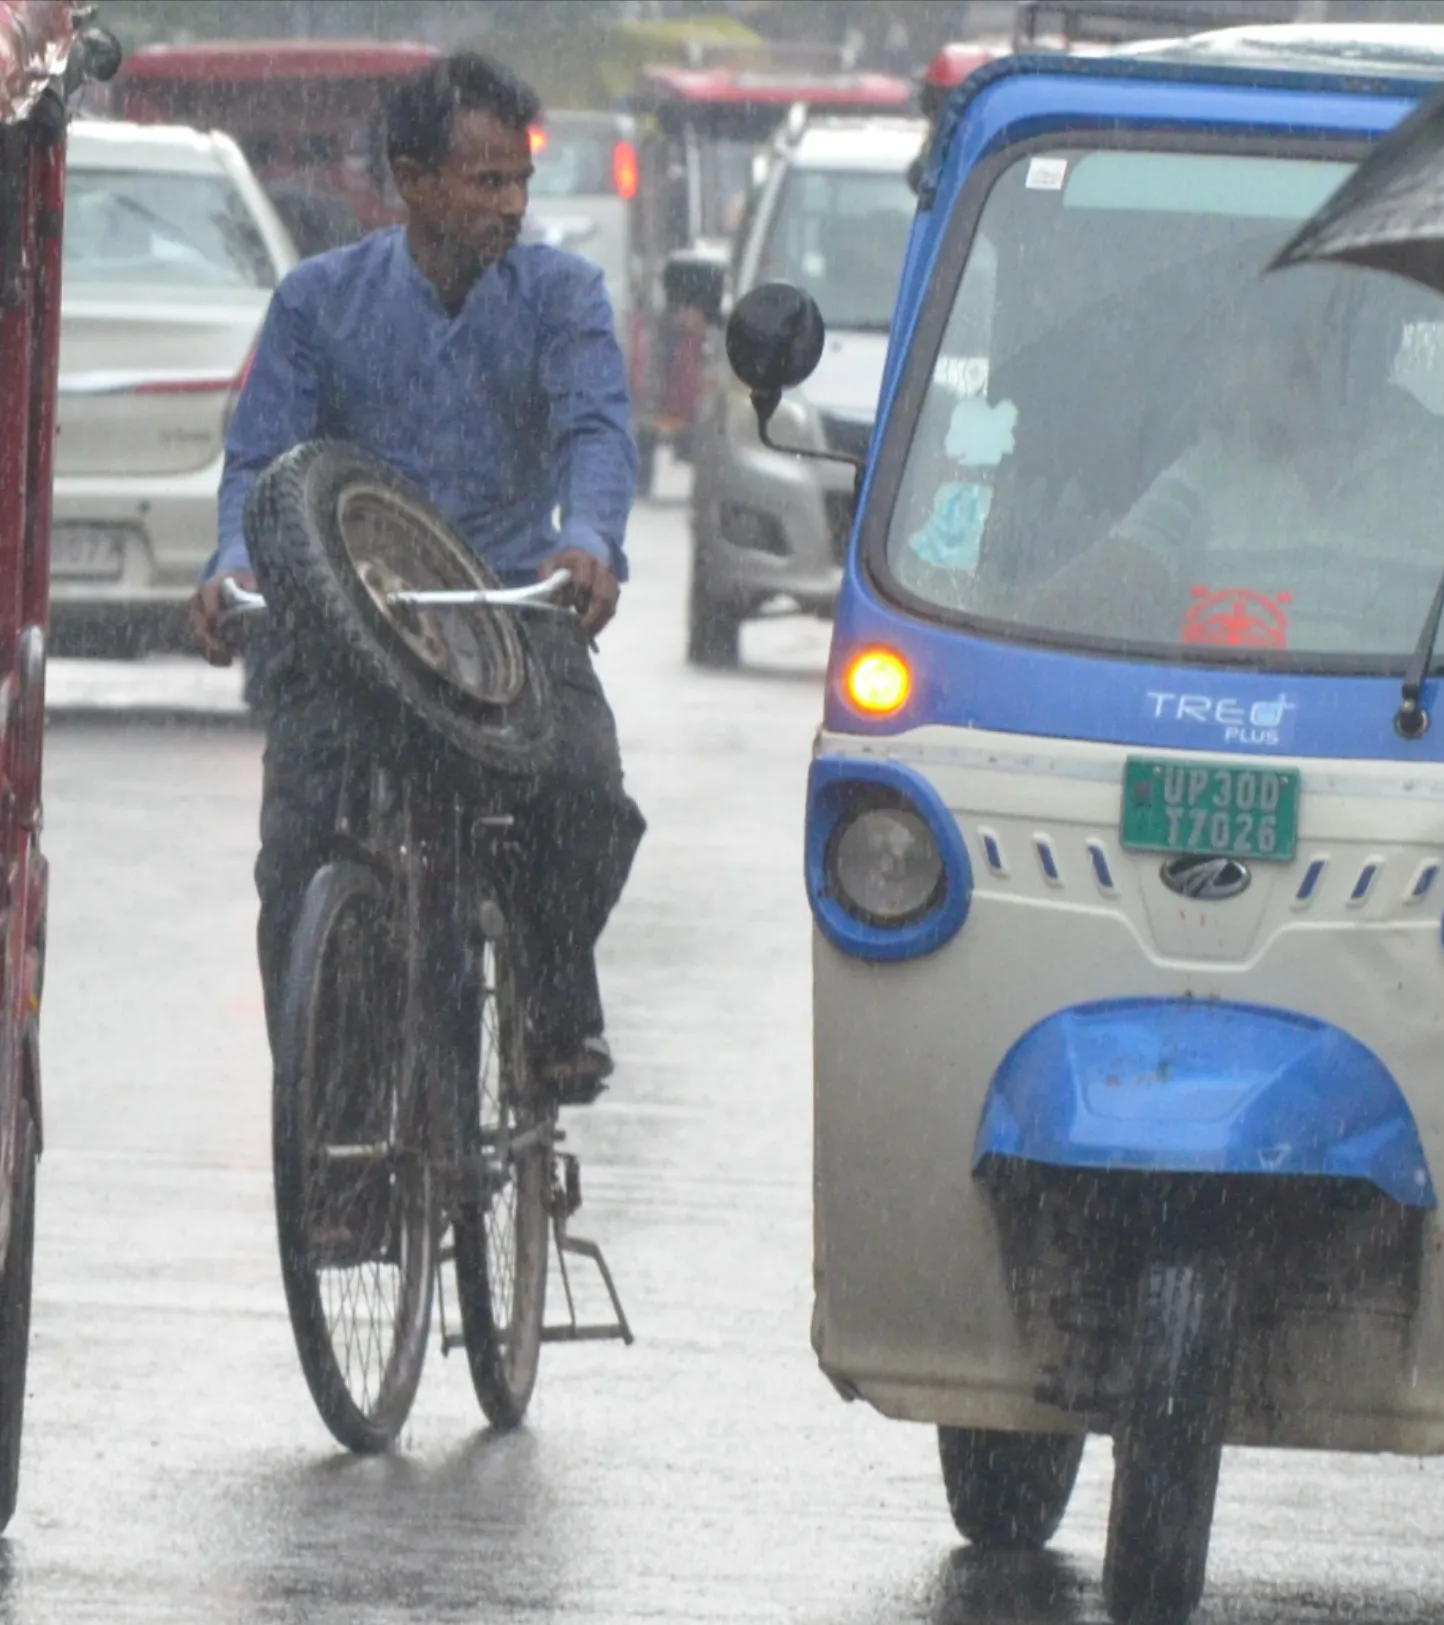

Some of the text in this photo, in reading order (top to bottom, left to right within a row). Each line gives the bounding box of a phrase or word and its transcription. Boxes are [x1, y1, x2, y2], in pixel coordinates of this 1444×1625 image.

[1225, 727, 1279, 745] PLUS
[1163, 767, 1280, 812] UP30D
[1164, 807, 1277, 852] T7026
